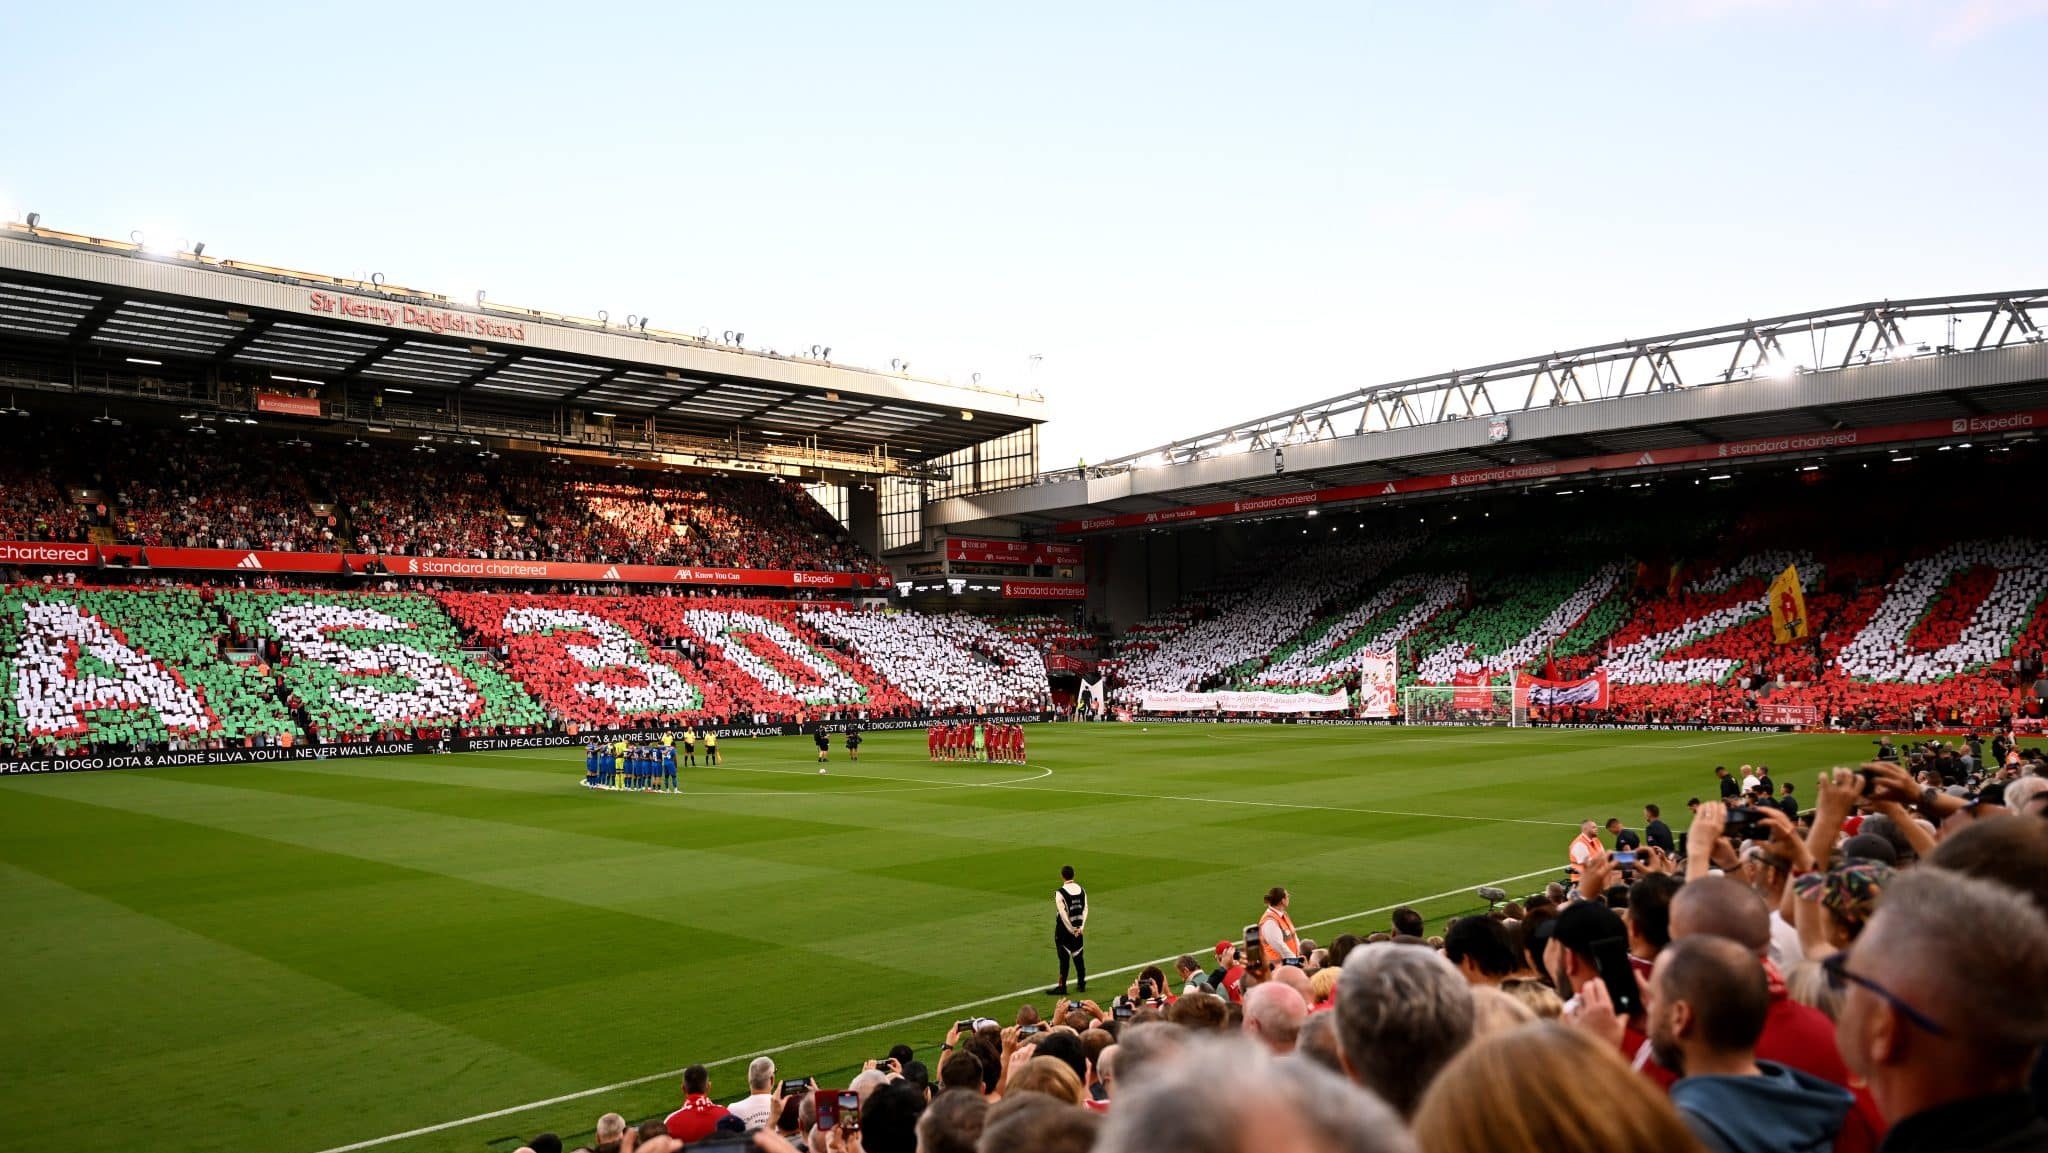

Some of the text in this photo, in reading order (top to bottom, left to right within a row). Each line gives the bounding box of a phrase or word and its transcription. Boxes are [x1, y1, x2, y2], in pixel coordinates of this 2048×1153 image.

[310, 291, 525, 341] Sir Kenny Dalglish Stand
[1970, 414, 2034, 431] Expedia
[1729, 431, 1857, 456] standard chartered
[1460, 463, 1557, 485] standard chartered
[1240, 493, 1317, 511] standard chartered
[1089, 518, 1115, 529] Expedia
[0, 546, 88, 561] chartered
[422, 560, 547, 576] standard chartered
[674, 569, 693, 580] AXA
[695, 571, 741, 581] Know You Can
[802, 573, 835, 585] Expedia
[1013, 586, 1049, 596] standard
[1049, 586, 1086, 597] chartered
[895, 721, 911, 729] JOTA
[469, 738, 496, 750] REST
[497, 738, 508, 749] IN
[510, 737, 544, 748] PEACE
[544, 736, 576, 747] DIOG
[603, 734, 610, 744] &
[731, 728, 756, 738] WALK
[756, 726, 783, 737] ALONE
[0, 760, 50, 774] PEACE
[54, 758, 103, 770] DIOGO
[106, 756, 141, 769] JOTA
[144, 755, 154, 767] &
[156, 750, 204, 766] ANDRÉ
[208, 750, 247, 764] SILVA.
[296, 746, 338, 759] NEVER
[340, 744, 371, 756] WALK
[374, 743, 414, 754] ALONE
